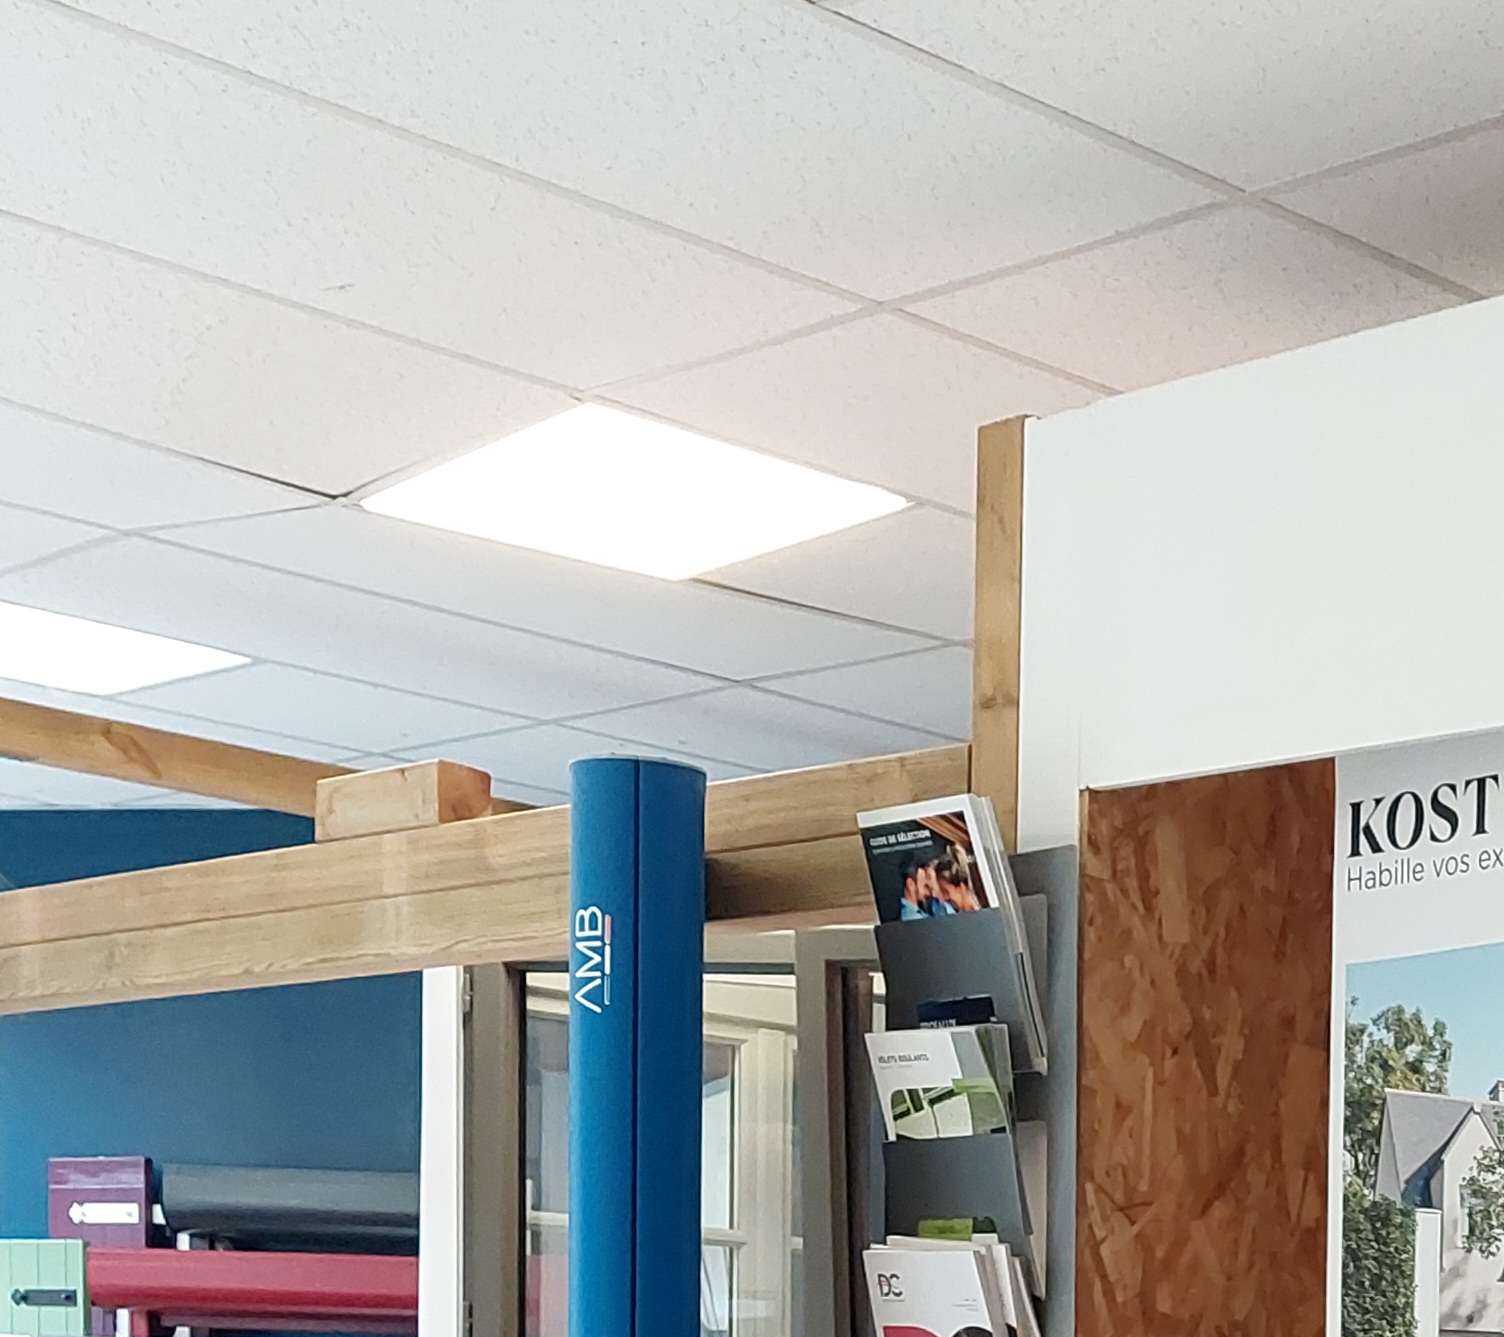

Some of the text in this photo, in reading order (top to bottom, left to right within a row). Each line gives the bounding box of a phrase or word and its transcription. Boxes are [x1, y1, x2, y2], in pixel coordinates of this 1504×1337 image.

[1346, 856, 1425, 892] Habille
[1432, 852, 1470, 878] vos
[574, 905, 603, 1014] AMB
